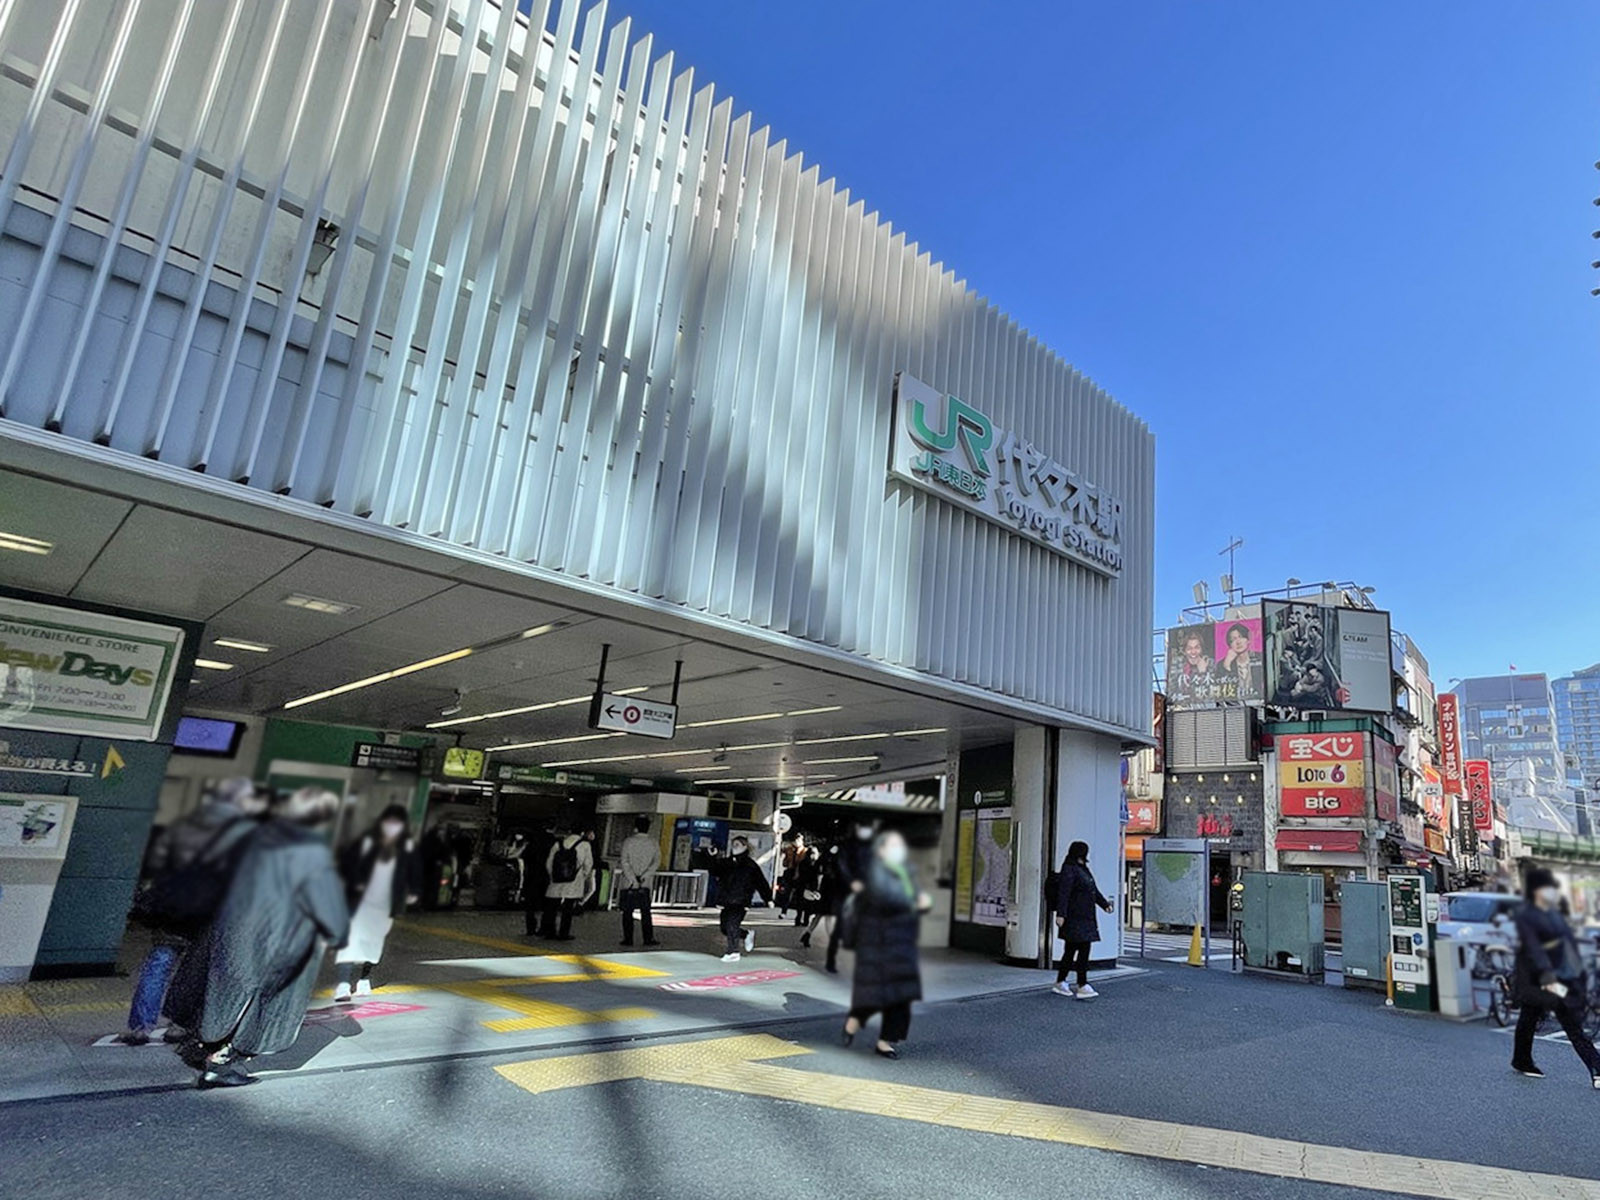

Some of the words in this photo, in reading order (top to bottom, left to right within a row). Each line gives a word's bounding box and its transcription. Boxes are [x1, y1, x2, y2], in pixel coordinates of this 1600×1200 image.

[912, 393, 993, 474] JR
[914, 453, 988, 500] JR東日本
[1001, 430, 1121, 545] 代々木駅
[1002, 491, 1061, 539] Yoyogi
[1065, 524, 1122, 571] Station
[96, 639, 140, 653] STORE
[1289, 737, 1354, 759] 宝くじ
[1298, 767, 1326, 783] LOTO
[1331, 763, 1345, 783] 6
